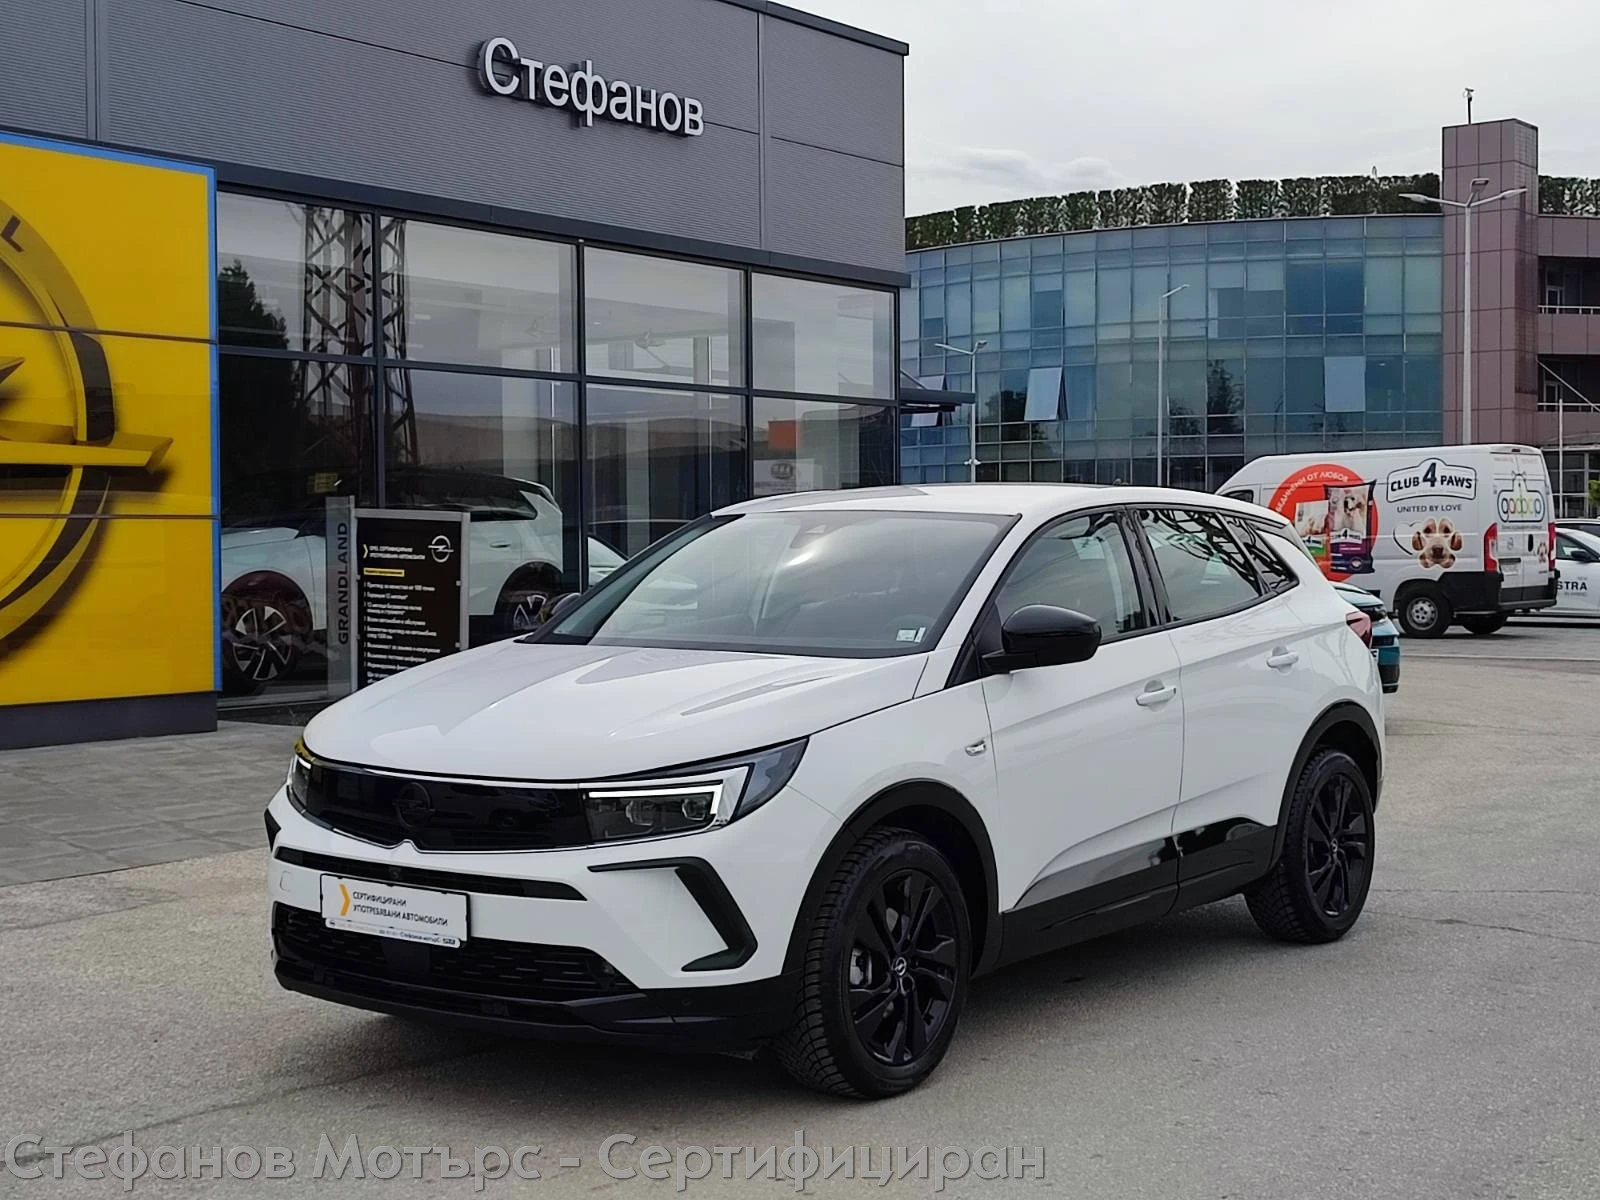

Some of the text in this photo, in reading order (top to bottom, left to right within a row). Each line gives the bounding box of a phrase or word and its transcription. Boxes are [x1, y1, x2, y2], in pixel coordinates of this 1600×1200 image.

[482, 37, 704, 136] Стефанов
[1307, 472, 1318, 481] ОТ
[1391, 462, 1473, 492] CLUB 4 PAWS
[1397, 505, 1427, 513] UNITED
[1441, 504, 1462, 512] LOVE
[338, 522, 348, 645] GRANDLAND
[1557, 581, 1588, 591] STRA
[352, 891, 407, 906] СЕРТИФИЦИРАНИ
[353, 904, 448, 926] УПОТРЕБЯВАНИ АВТОМОБИЛИ
